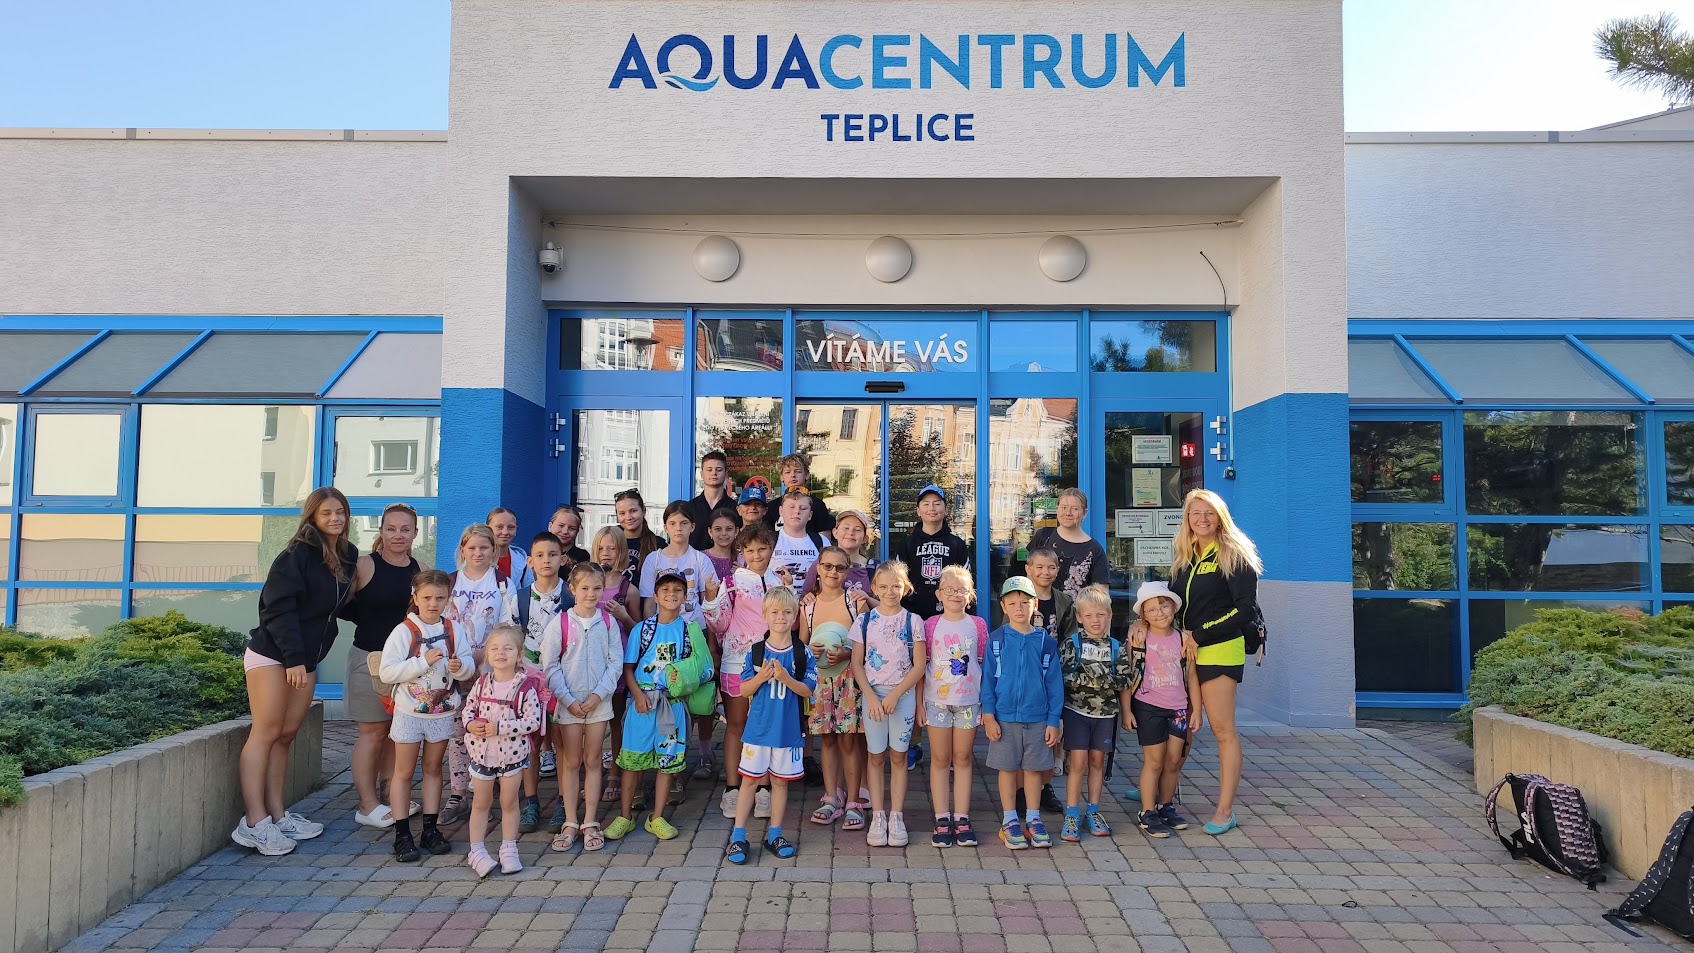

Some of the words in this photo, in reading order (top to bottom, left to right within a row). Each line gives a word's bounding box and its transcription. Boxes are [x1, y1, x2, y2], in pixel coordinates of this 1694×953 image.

[608, 32, 1185, 91] AQUACENTRUM
[820, 113, 975, 142] TEPLICE
[806, 332, 906, 363] VÍTÁME
[914, 332, 968, 363] VÁS
[916, 545, 950, 556] LEAGUE
[924, 565, 940, 577] NFL
[768, 677, 786, 700] 10
[789, 747, 800, 763] 10
[1521, 811, 1535, 844] FILA
